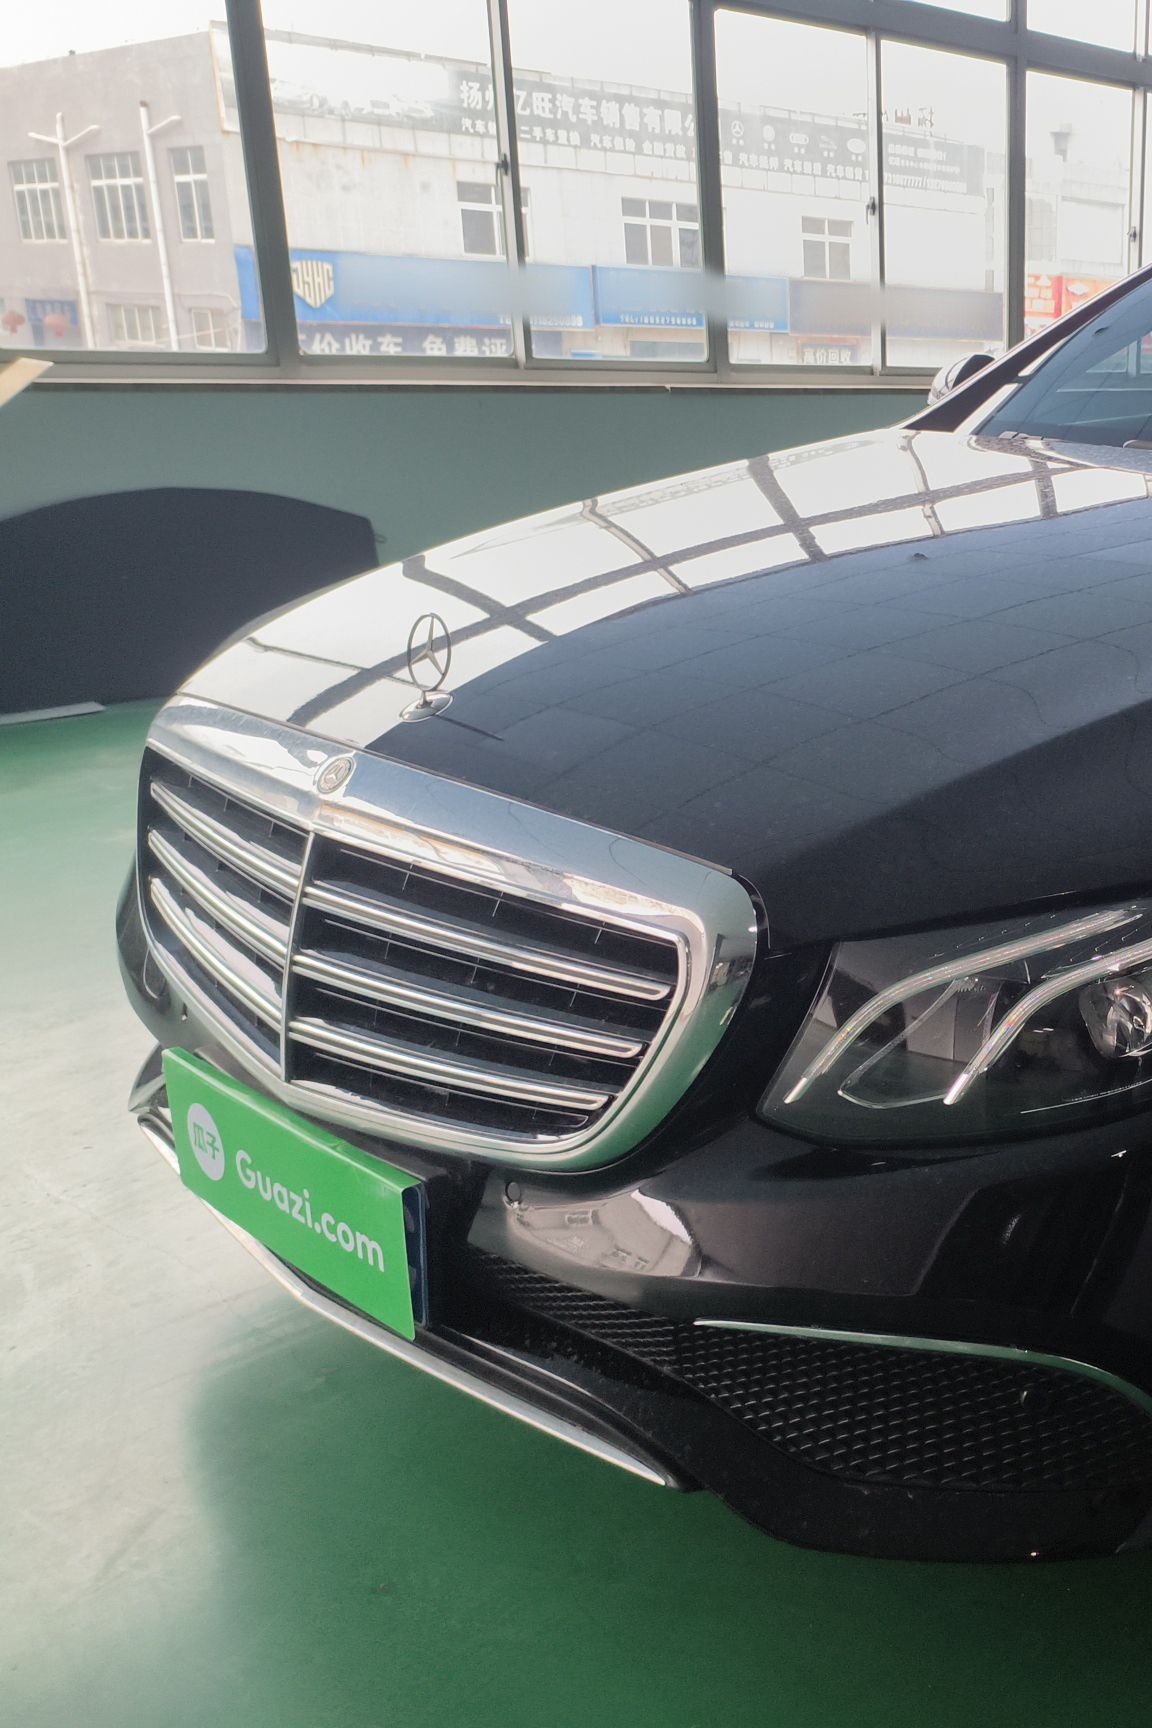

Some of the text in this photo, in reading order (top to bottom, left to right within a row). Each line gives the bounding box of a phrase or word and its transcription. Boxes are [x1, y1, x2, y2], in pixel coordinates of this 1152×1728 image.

[299, 331, 403, 356] 价收车
[194, 1122, 221, 1161] 瓜子
[236, 1149, 385, 1273] Guazi.com
